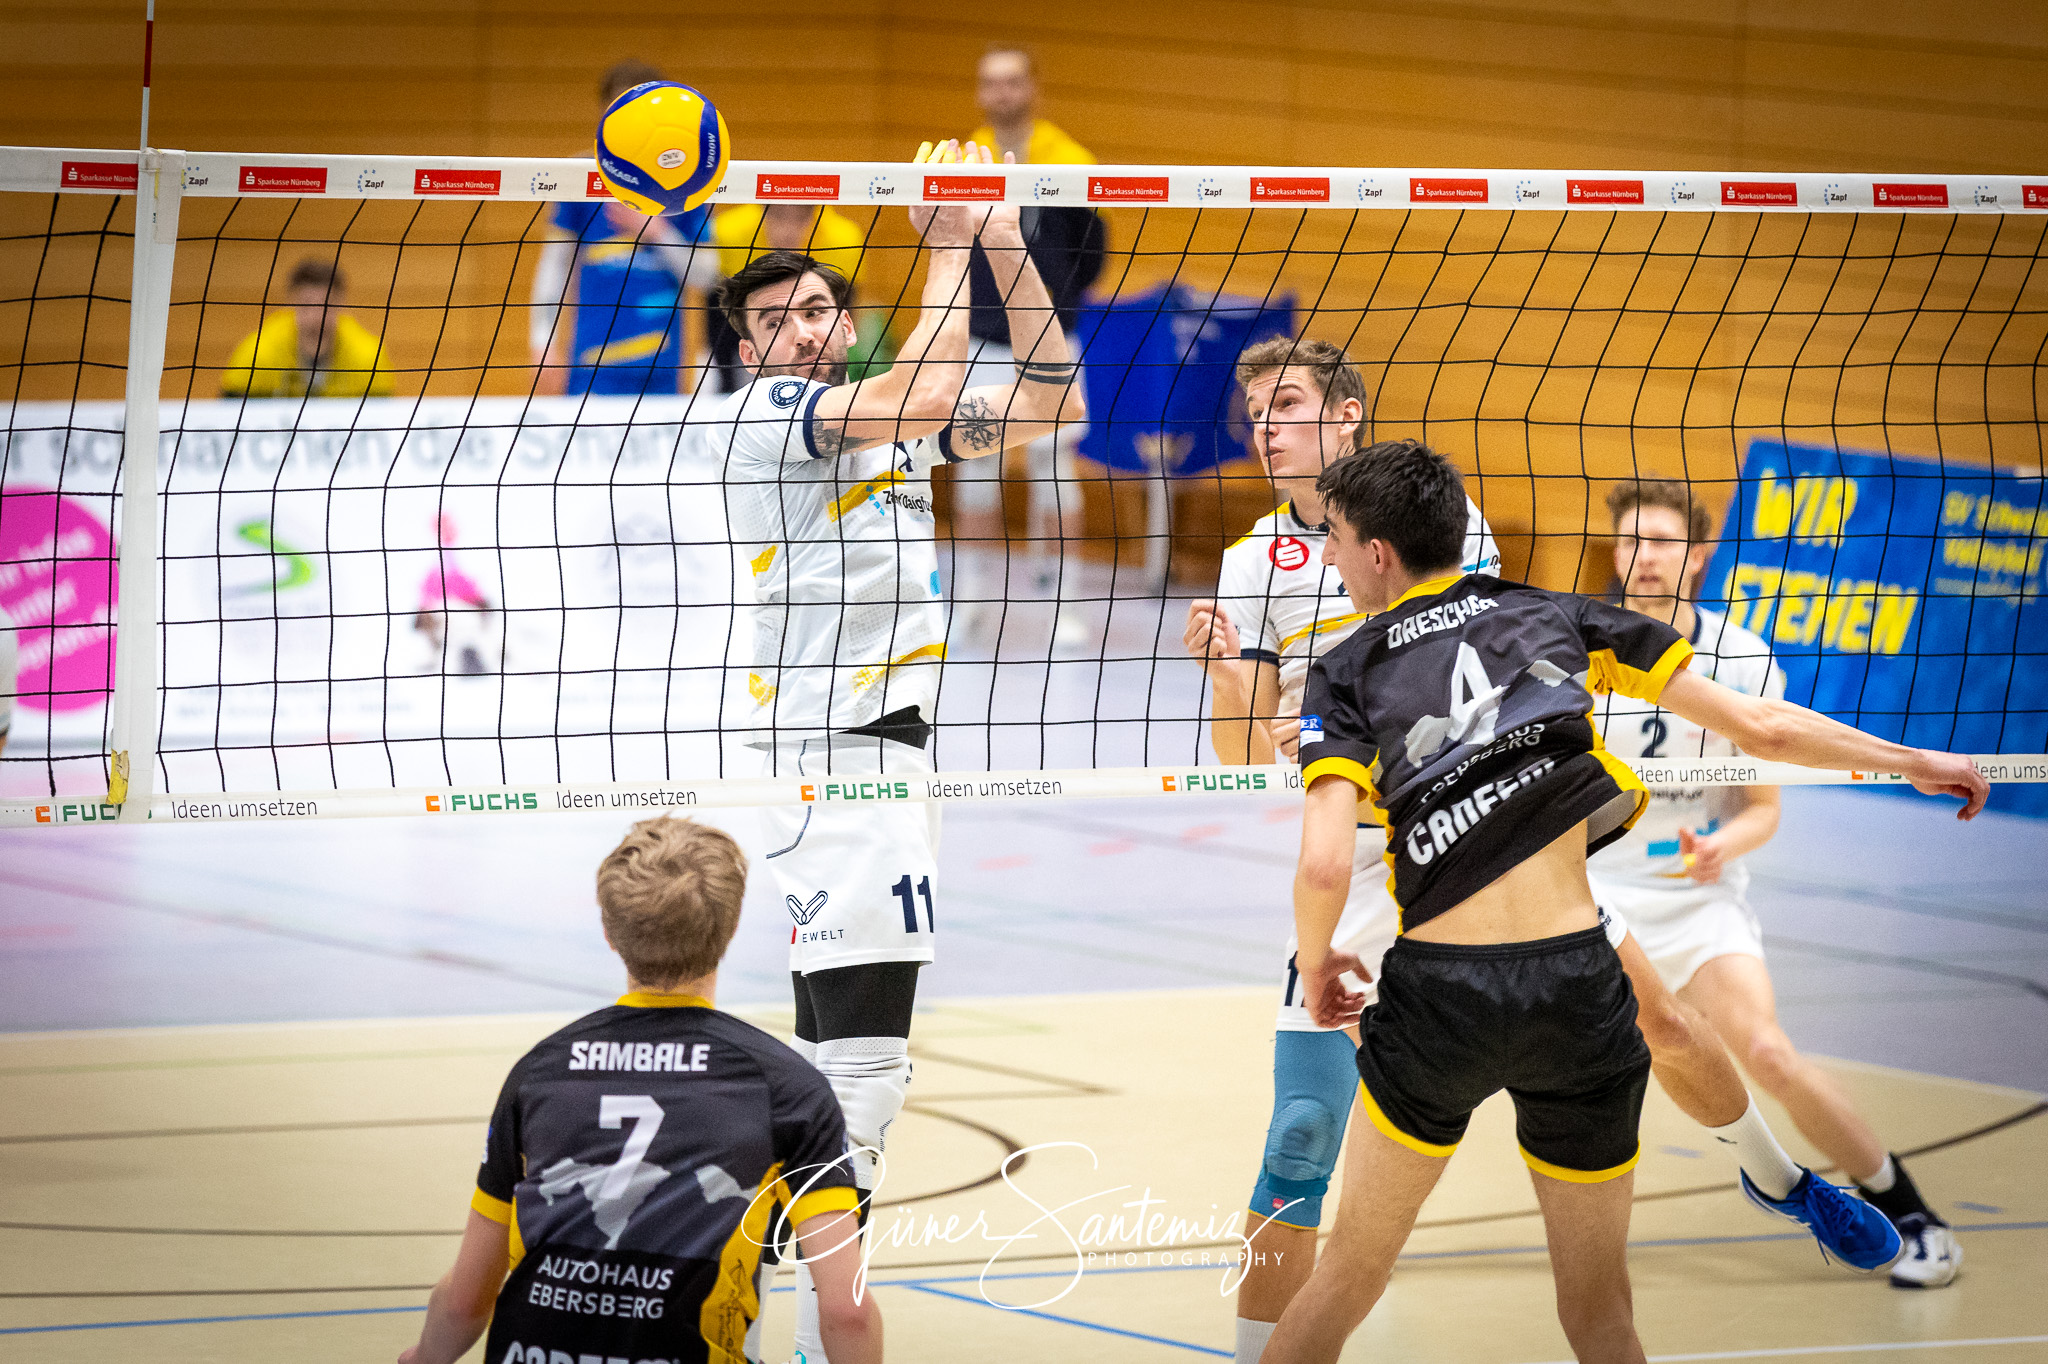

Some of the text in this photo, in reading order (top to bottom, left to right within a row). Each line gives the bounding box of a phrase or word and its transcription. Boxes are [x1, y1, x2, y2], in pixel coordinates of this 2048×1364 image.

[188, 177, 209, 187] Zapf
[257, 177, 289, 187] Sparkasse
[290, 178, 321, 188] Nürnberg
[364, 179, 385, 189] Zapf
[432, 180, 464, 190] Sparkasse
[465, 181, 495, 190] Nürnberg
[537, 182, 558, 191] Zapf
[713, 185, 728, 195] apf
[774, 185, 805, 194] Sparkasse
[805, 186, 834, 194] Nürnberg
[876, 186, 895, 195] Zapf
[941, 187, 971, 195] Sparkasse
[972, 187, 1000, 196] Nürnberg
[1041, 187, 1060, 197] Zapf
[1104, 187, 1135, 196] Sparkasse
[1136, 188, 1164, 196] Nürnberg
[1204, 188, 1223, 198] Zapf
[1267, 188, 1297, 196] Sparkasse
[1297, 188, 1325, 197] Nürnberg
[1365, 189, 1383, 198] Zapf
[1426, 189, 1456, 197] Sparkasse
[1456, 189, 1484, 198] Nürnberg
[1522, 190, 1540, 199] Zapf
[1583, 190, 1612, 198] Sparkasse
[1612, 190, 1639, 199] Nürnberg
[1677, 191, 1695, 201] Zapf
[1737, 192, 1766, 200] Sparkasse
[1766, 193, 1793, 201] Nürnberg
[1830, 193, 1848, 202] Zapf
[1980, 194, 1998, 204] Zapf
[1753, 468, 1858, 548] WIR
[1722, 563, 1919, 658] STEHEN
[1450, 641, 1504, 741] 4
[1640, 716, 1669, 758] 2
[1630, 764, 1757, 783] deen umsetzen
[1186, 773, 1267, 791] FUCHS
[1284, 770, 1305, 789] Ide
[825, 777, 1062, 801] FUCHS Ideen umsetzen
[452, 788, 697, 811] FUCHS Ideen umsetzen
[63, 799, 318, 822] FUC Ideen umsetzen
[891, 874, 934, 934] 11
[802, 929, 844, 943] EWELT
[1284, 950, 1305, 1008] 1
[568, 1040, 710, 1072] SAMBALE
[599, 1094, 665, 1200] 7
[536, 1253, 675, 1292] AUTOHAUS
[527, 1280, 666, 1320] EBERSBERG
